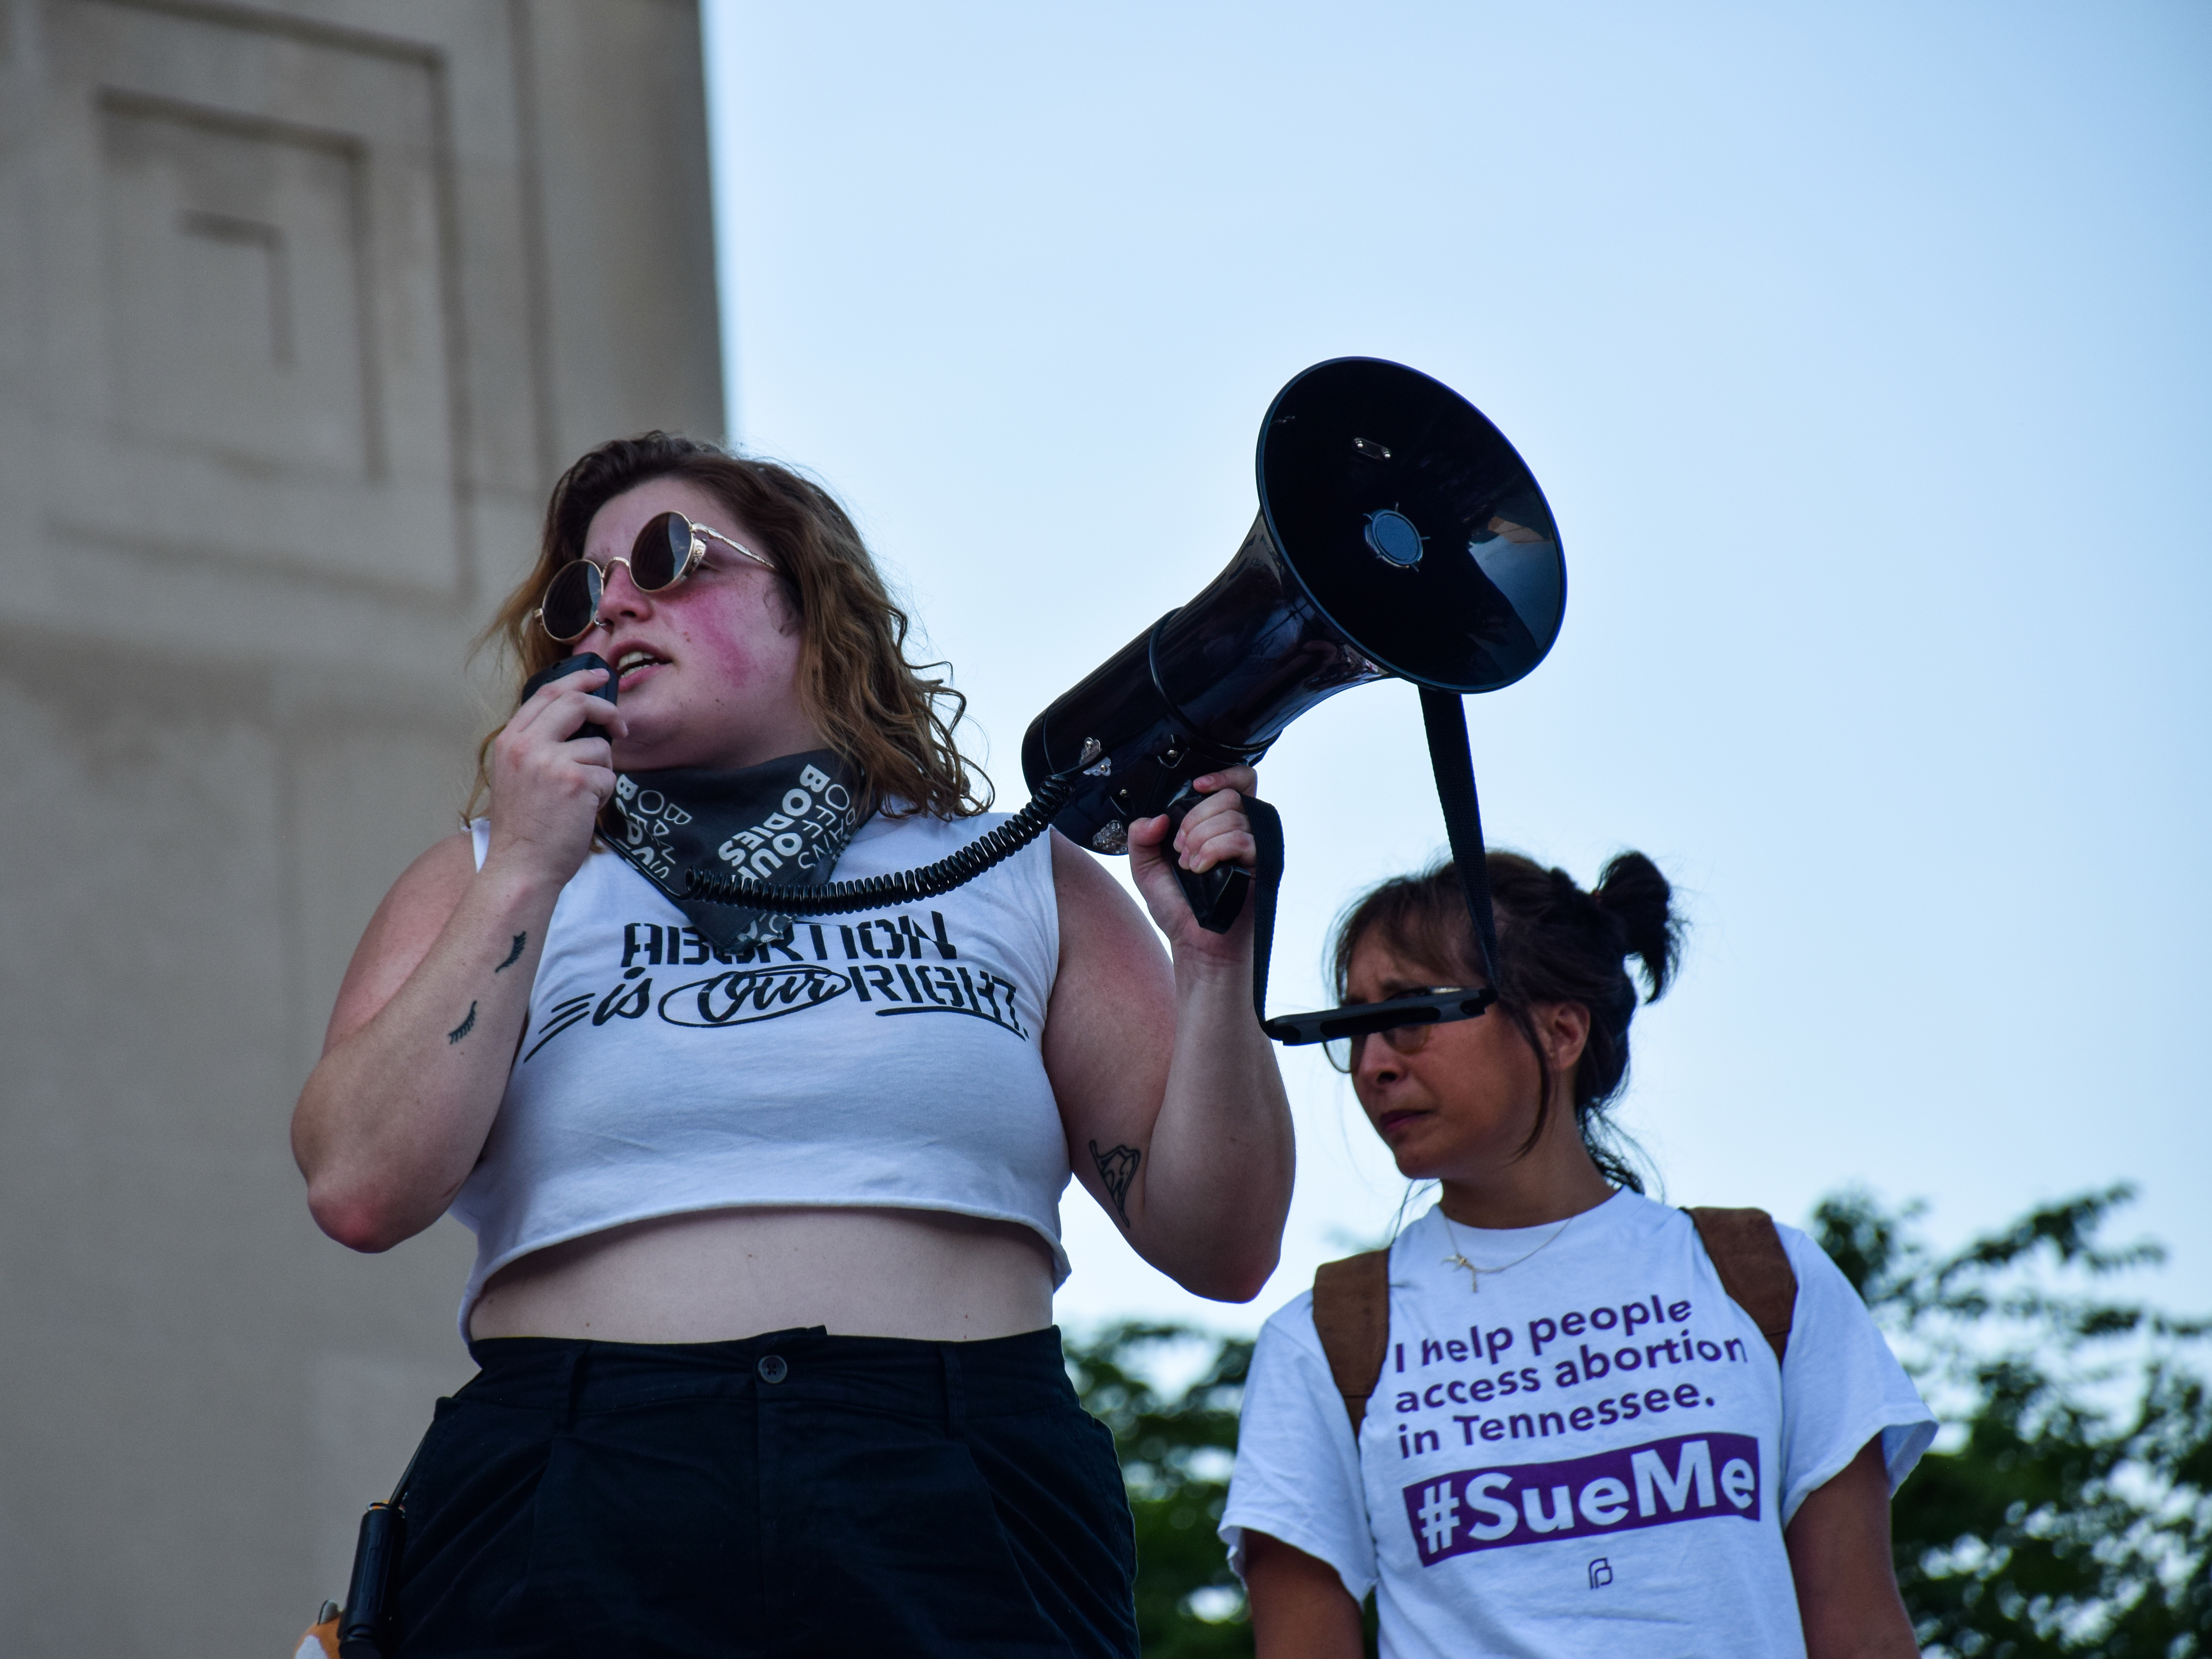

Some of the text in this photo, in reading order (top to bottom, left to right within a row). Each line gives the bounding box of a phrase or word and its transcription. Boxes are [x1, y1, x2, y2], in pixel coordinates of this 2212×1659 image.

[718, 764, 831, 867] BODIES
[802, 784, 850, 839] OFF
[592, 966, 653, 1026] is
[1395, 1294, 1693, 1373] I help people
[1395, 1330, 1748, 1413] access abortion
[1398, 1382, 1716, 1459] in Tennessee.
[1417, 1440, 1756, 1555] #SueMe
